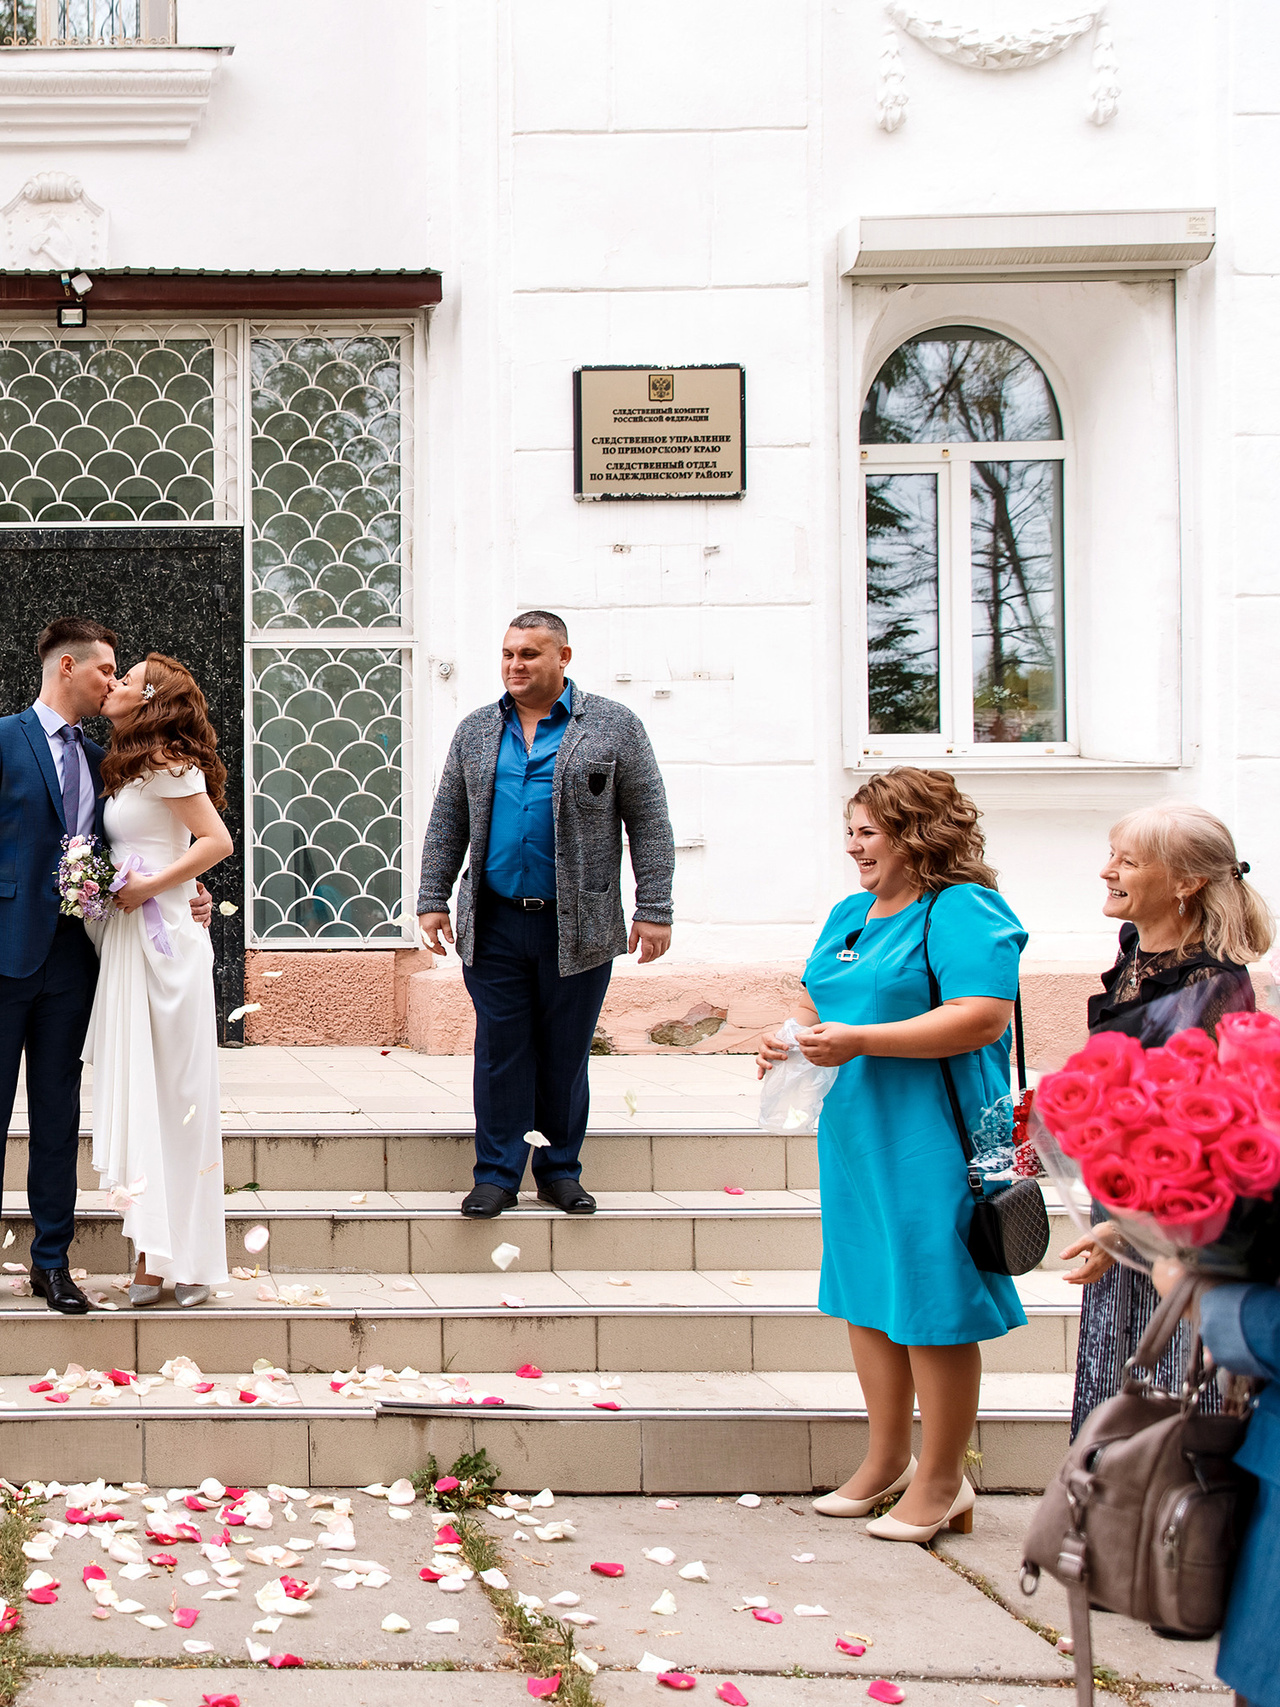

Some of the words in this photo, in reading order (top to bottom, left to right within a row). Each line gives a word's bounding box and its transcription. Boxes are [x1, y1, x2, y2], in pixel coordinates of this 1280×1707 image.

[613, 407, 672, 415] СЛЕДСТВЕННЫЙ
[613, 415, 663, 423] РОССИЙСКОЙ
[592, 436, 668, 445] СЛЕДСТВЕННОЕ
[669, 435, 731, 443] УПРАВЛЕНИЕ
[606, 461, 684, 470] СЛЕДСТВЕННЫЙ
[686, 461, 717, 469] ОТДЕЛ
[605, 472, 694, 481] НАДЕЖДИНСКОМУ
[695, 471, 733, 479] РАЙОНУ
